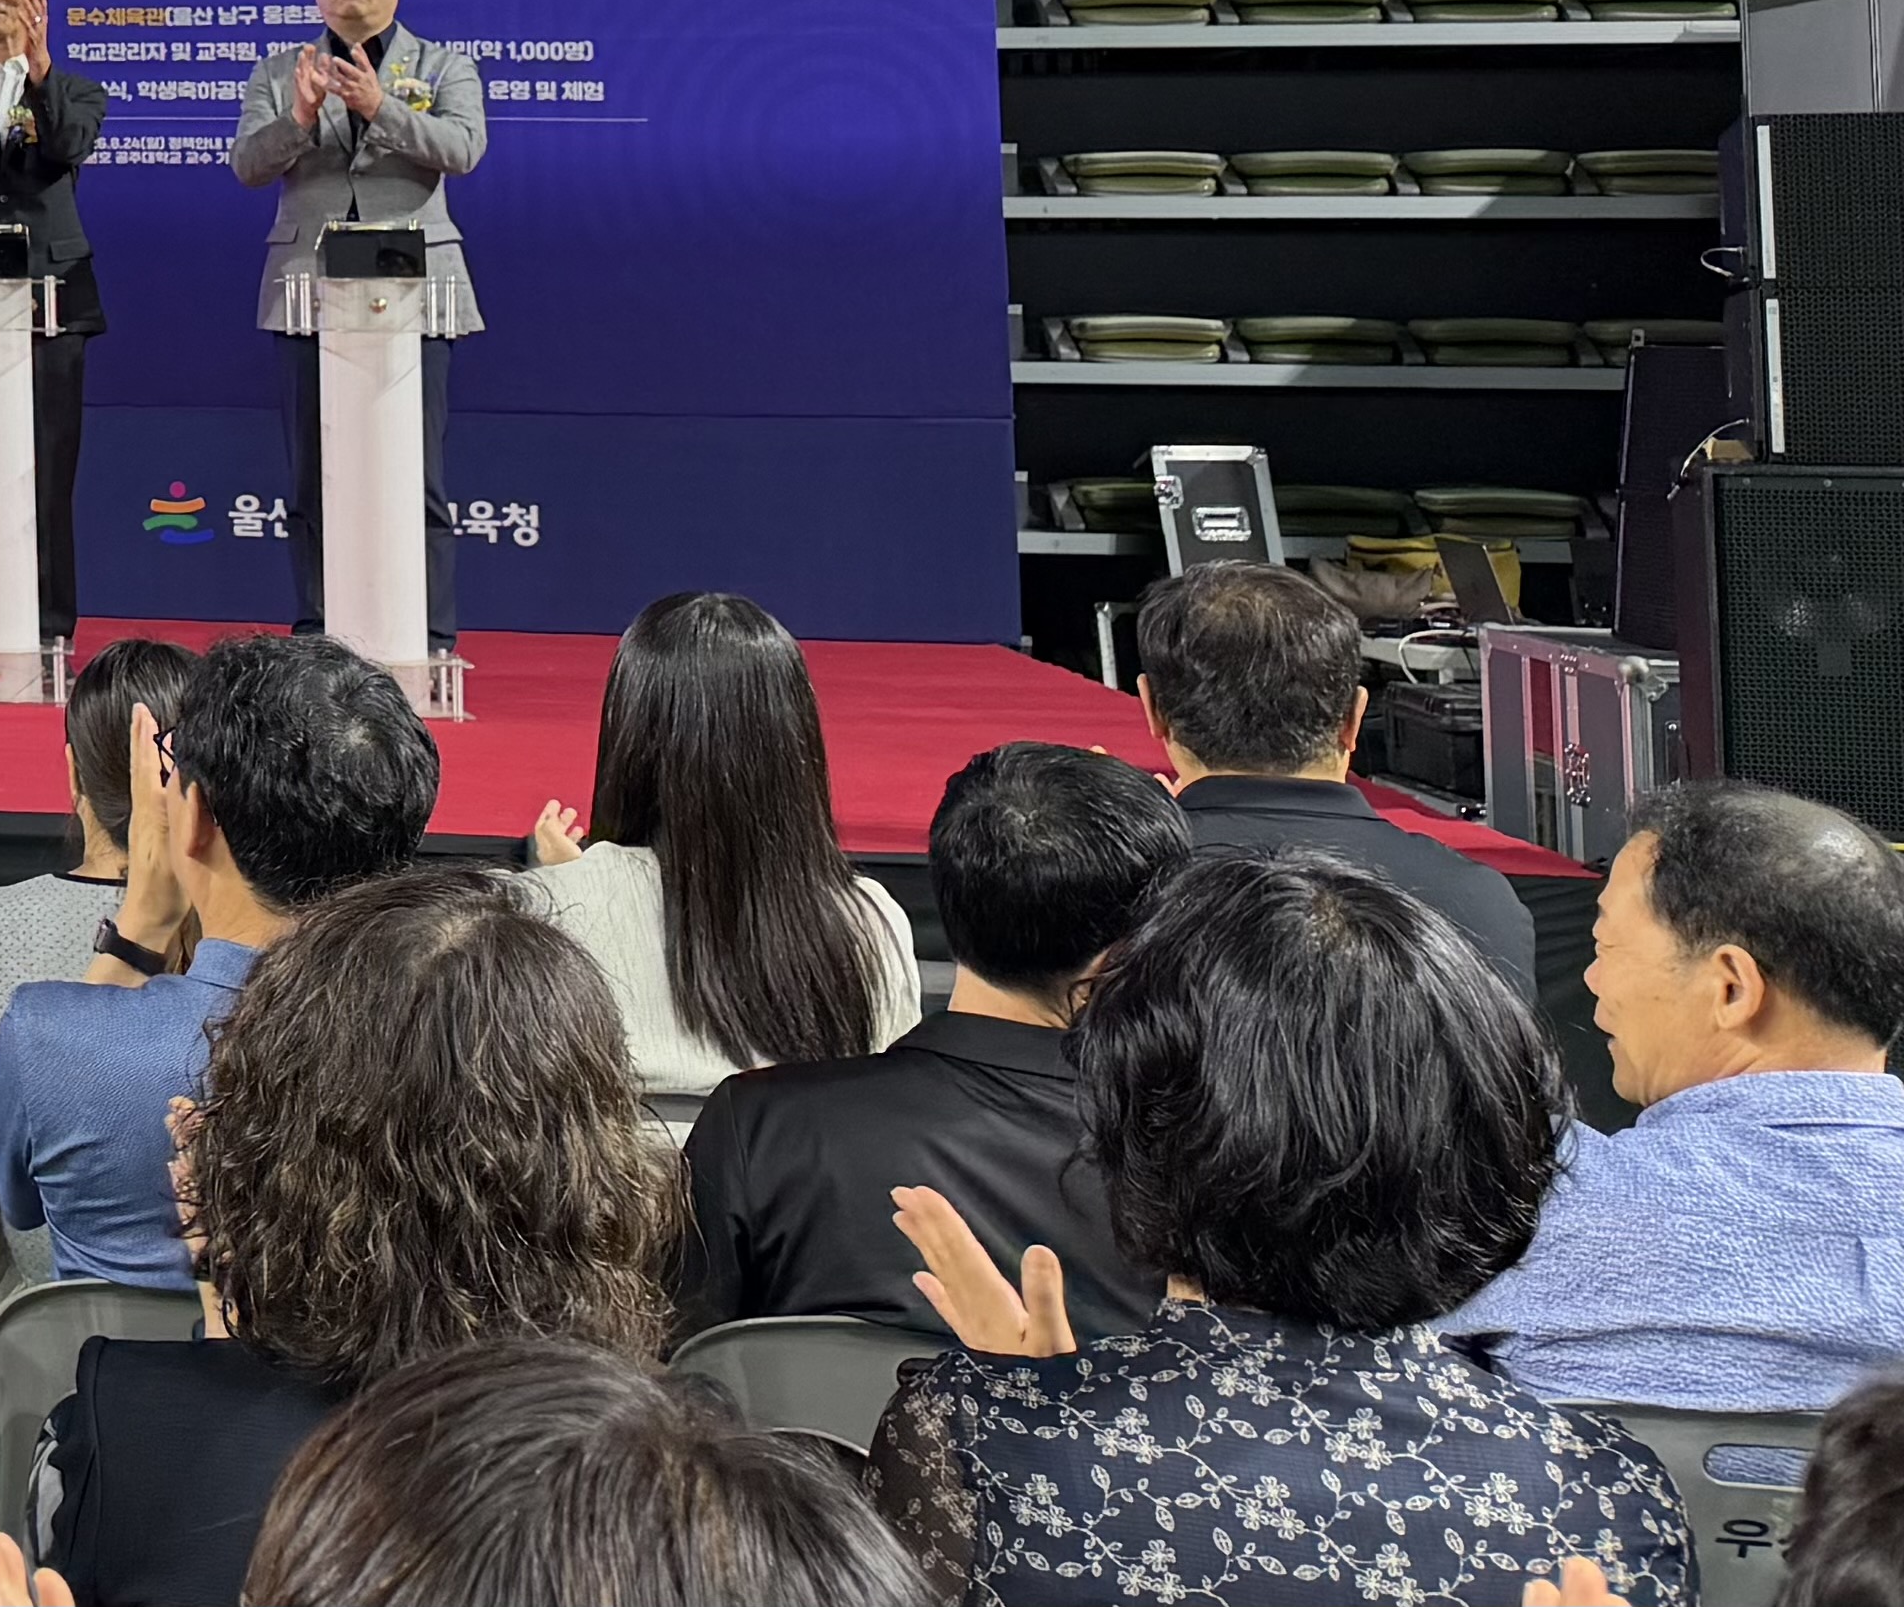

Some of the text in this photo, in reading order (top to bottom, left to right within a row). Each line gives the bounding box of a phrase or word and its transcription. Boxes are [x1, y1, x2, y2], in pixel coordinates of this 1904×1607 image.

[66, 6, 214, 27] 문수체육관(울산
[218, 6, 259, 25] 남구
[67, 41, 168, 62] 학교관리자
[171, 42, 192, 62] 및
[507, 40, 595, 62] 1,000명)
[488, 80, 531, 101] 운영
[535, 81, 558, 101] 및
[561, 80, 606, 102] 체험
[115, 151, 182, 165] 공주대학교
[185, 151, 212, 165] 교수
